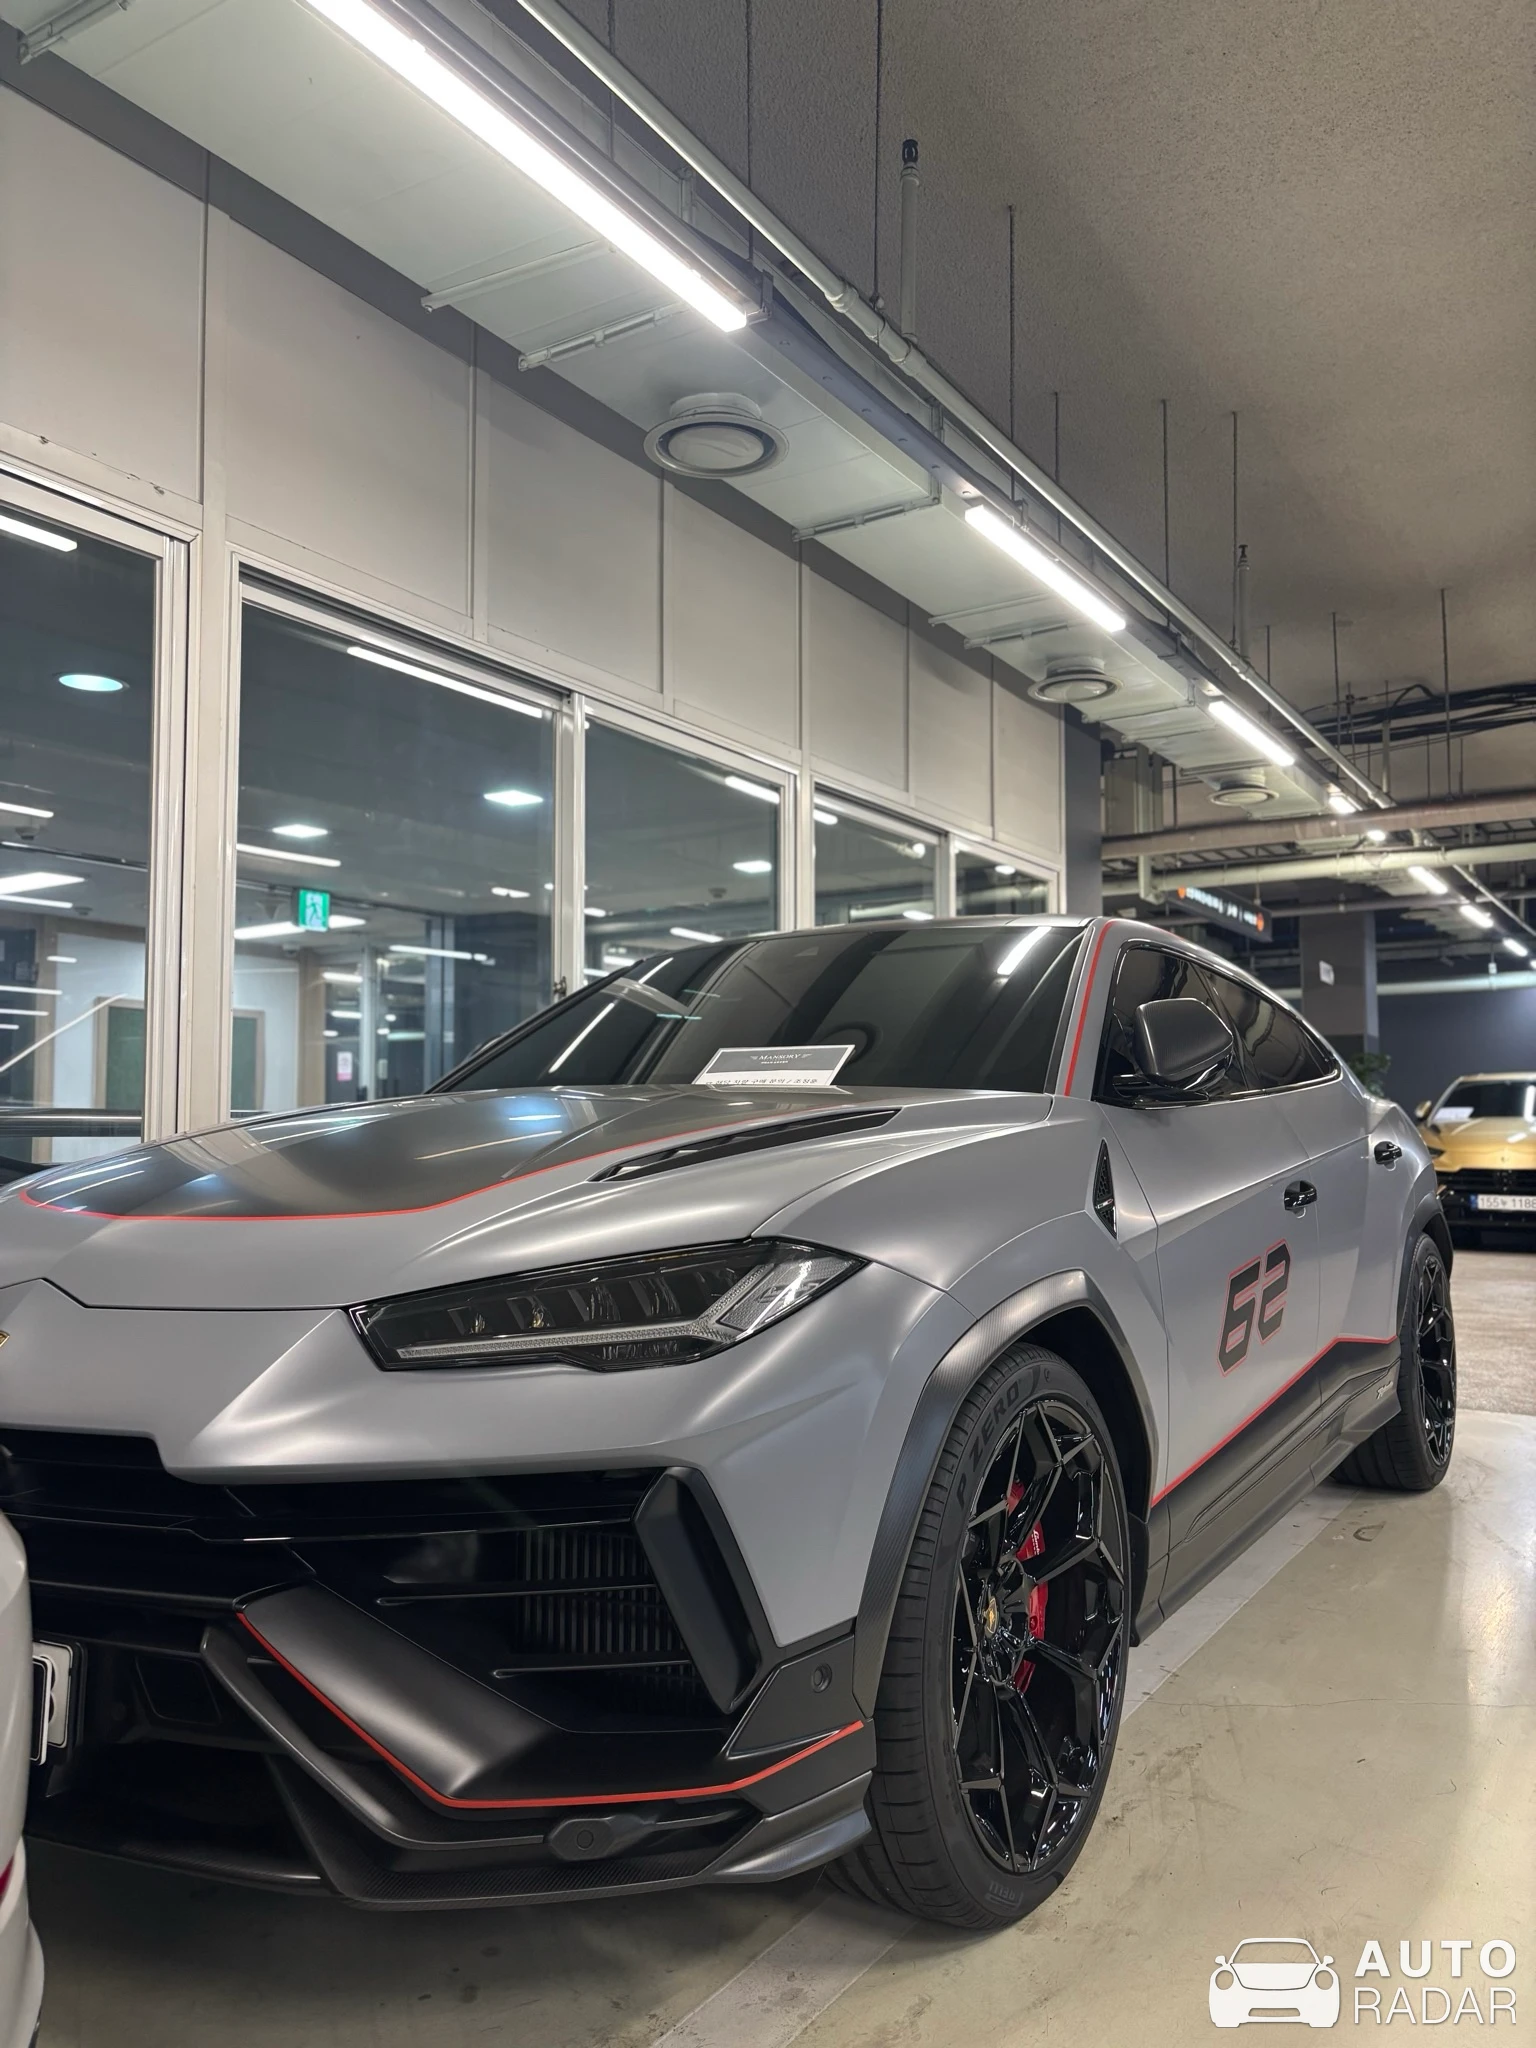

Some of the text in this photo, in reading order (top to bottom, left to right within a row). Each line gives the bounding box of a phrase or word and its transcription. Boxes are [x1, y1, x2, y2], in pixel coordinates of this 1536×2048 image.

[1217, 1240, 1291, 1375] 62
[956, 1381, 1020, 1509] P ZERO
